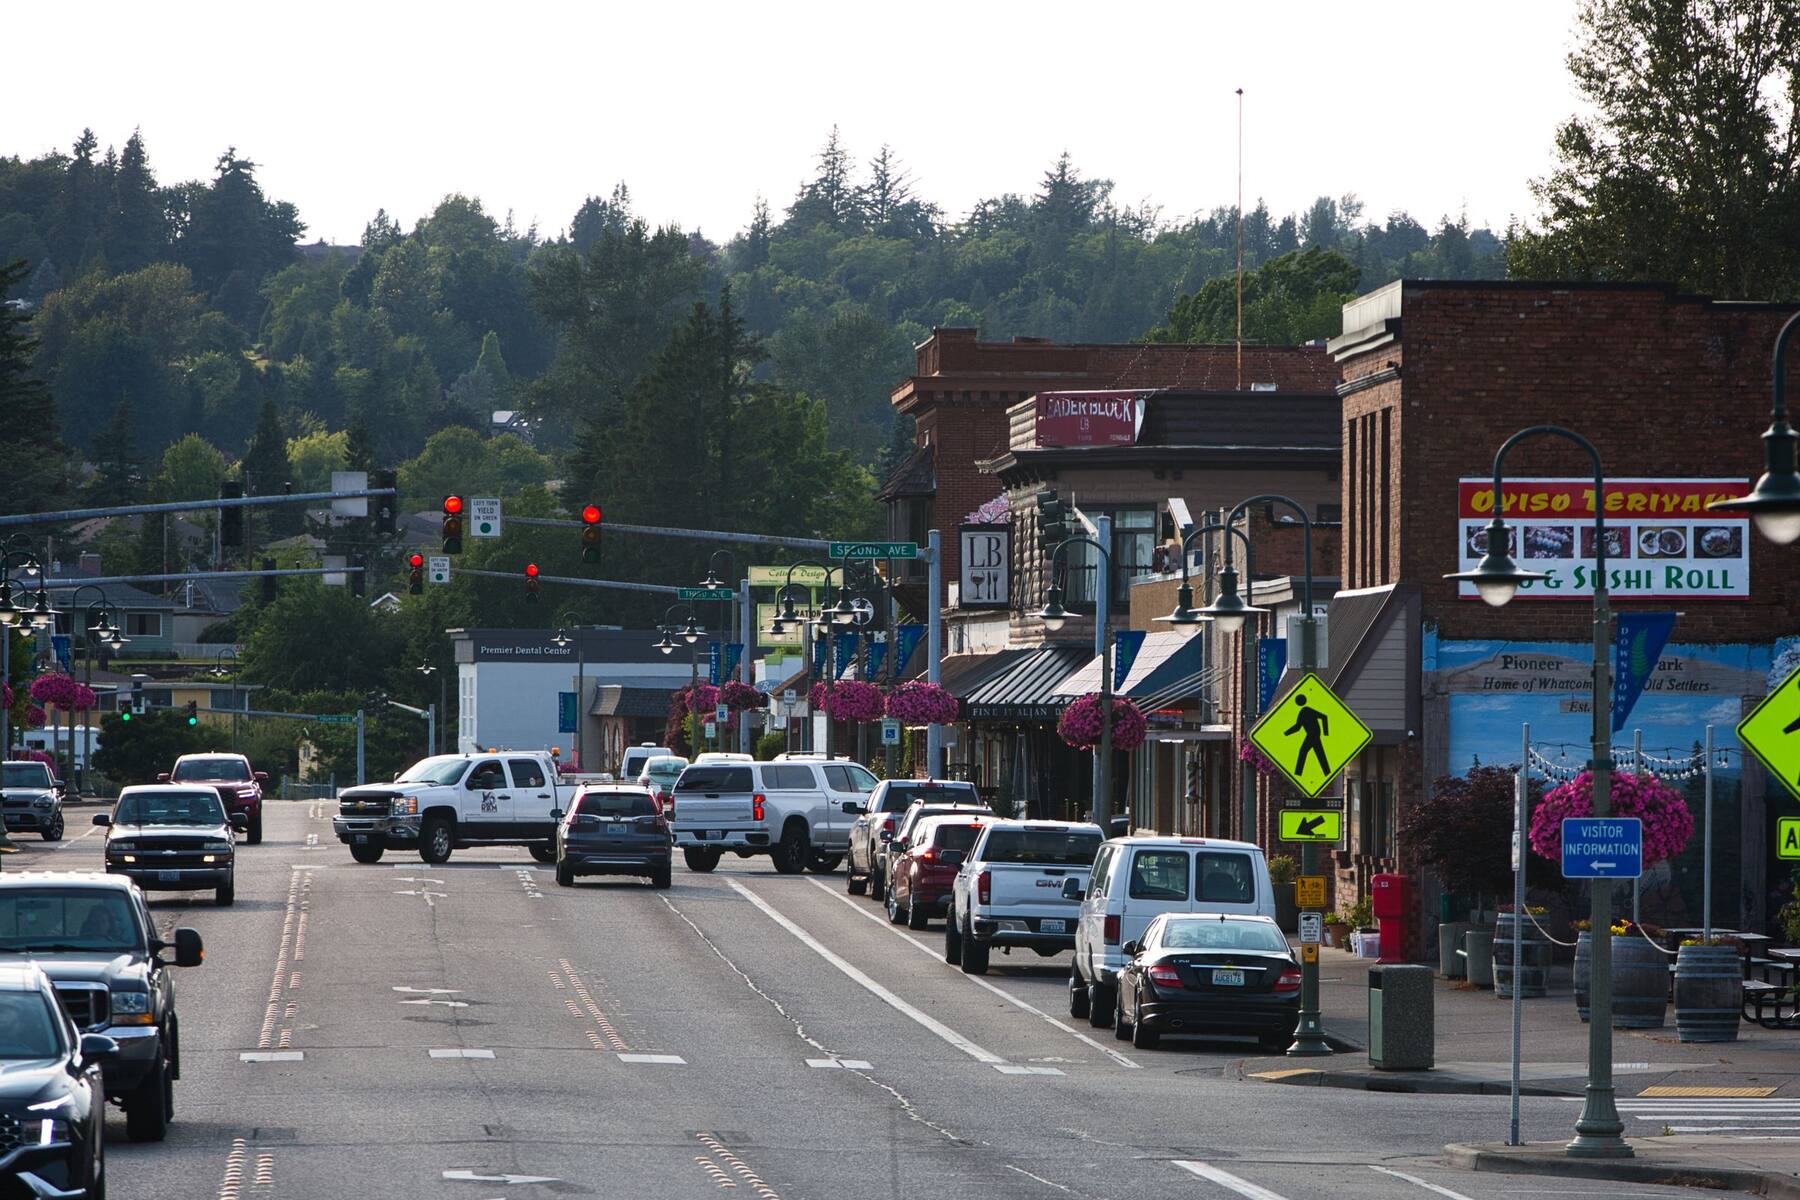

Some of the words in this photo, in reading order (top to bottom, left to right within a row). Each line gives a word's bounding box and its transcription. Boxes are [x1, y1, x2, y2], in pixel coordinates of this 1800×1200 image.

[1039, 397, 1088, 420] EADER
[1089, 398, 1132, 422] BLOCK
[836, 545, 880, 556] SECOND
[967, 536, 1002, 568] LB
[801, 569, 826, 579] Design
[1665, 565, 1735, 590] ROLL
[480, 645, 513, 654] Premier
[515, 645, 542, 655] Dental
[543, 646, 571, 655] Center
[1501, 655, 1563, 671] Pioneer
[1658, 658, 1683, 671] ark
[1617, 626, 1630, 713] DOWNTOWN
[1483, 677, 1519, 690] Home
[1522, 677, 1537, 692] of
[1539, 677, 1593, 690] Whatcom
[1666, 678, 1711, 692] Settlers
[1580, 825, 1624, 839] VISITOR
[1785, 827, 1800, 850] A
[1565, 843, 1640, 857] INFORMATION
[1036, 879, 1065, 888] GM
